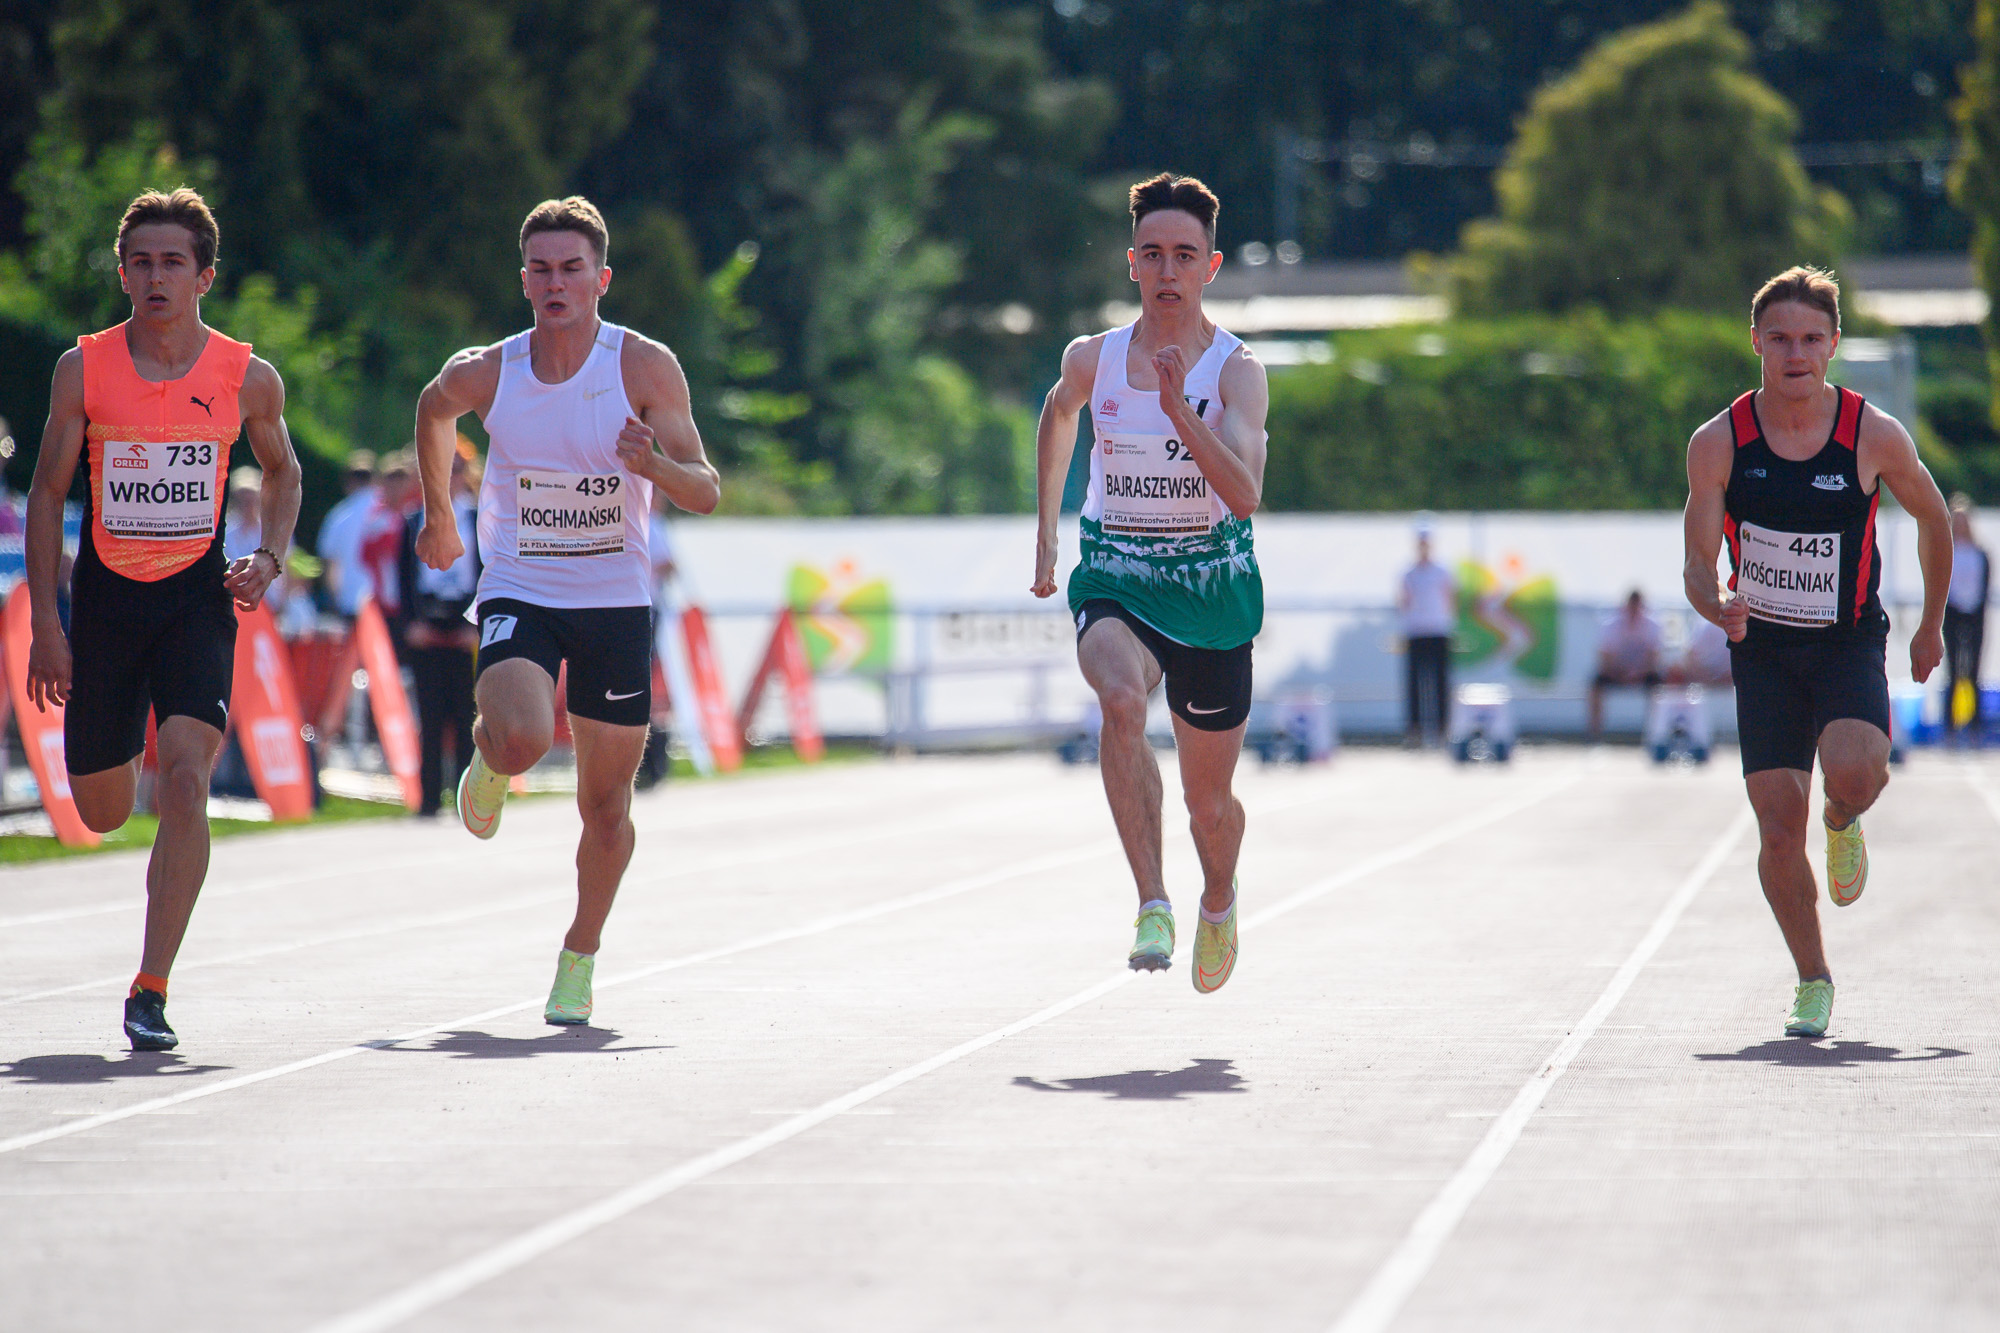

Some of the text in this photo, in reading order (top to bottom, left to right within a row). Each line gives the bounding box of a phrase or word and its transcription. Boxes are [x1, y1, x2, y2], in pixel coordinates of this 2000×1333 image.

[166, 445, 212, 466] 733
[1165, 439, 1195, 461] 92
[114, 459, 147, 468] ORLEN
[109, 478, 210, 504] WRÓBEL
[575, 476, 620, 496] 439
[1106, 474, 1206, 499] BAJRASZEWSKI
[181, 519, 200, 528] Polski
[521, 505, 621, 529] KOCHMAŃSKI
[1114, 515, 1128, 523] PZLA
[1129, 516, 1170, 524] Mistrzostwa
[1172, 516, 1194, 524] Polski
[1196, 515, 1209, 523] U18
[1789, 537, 1834, 558] 443
[1742, 558, 1835, 593] KOŚCIELNIAK
[1747, 598, 1760, 607] PZLA
[1761, 602, 1798, 615] Mistrzostwa
[1799, 609, 1820, 617] Polski
[489, 616, 509, 642] 7
